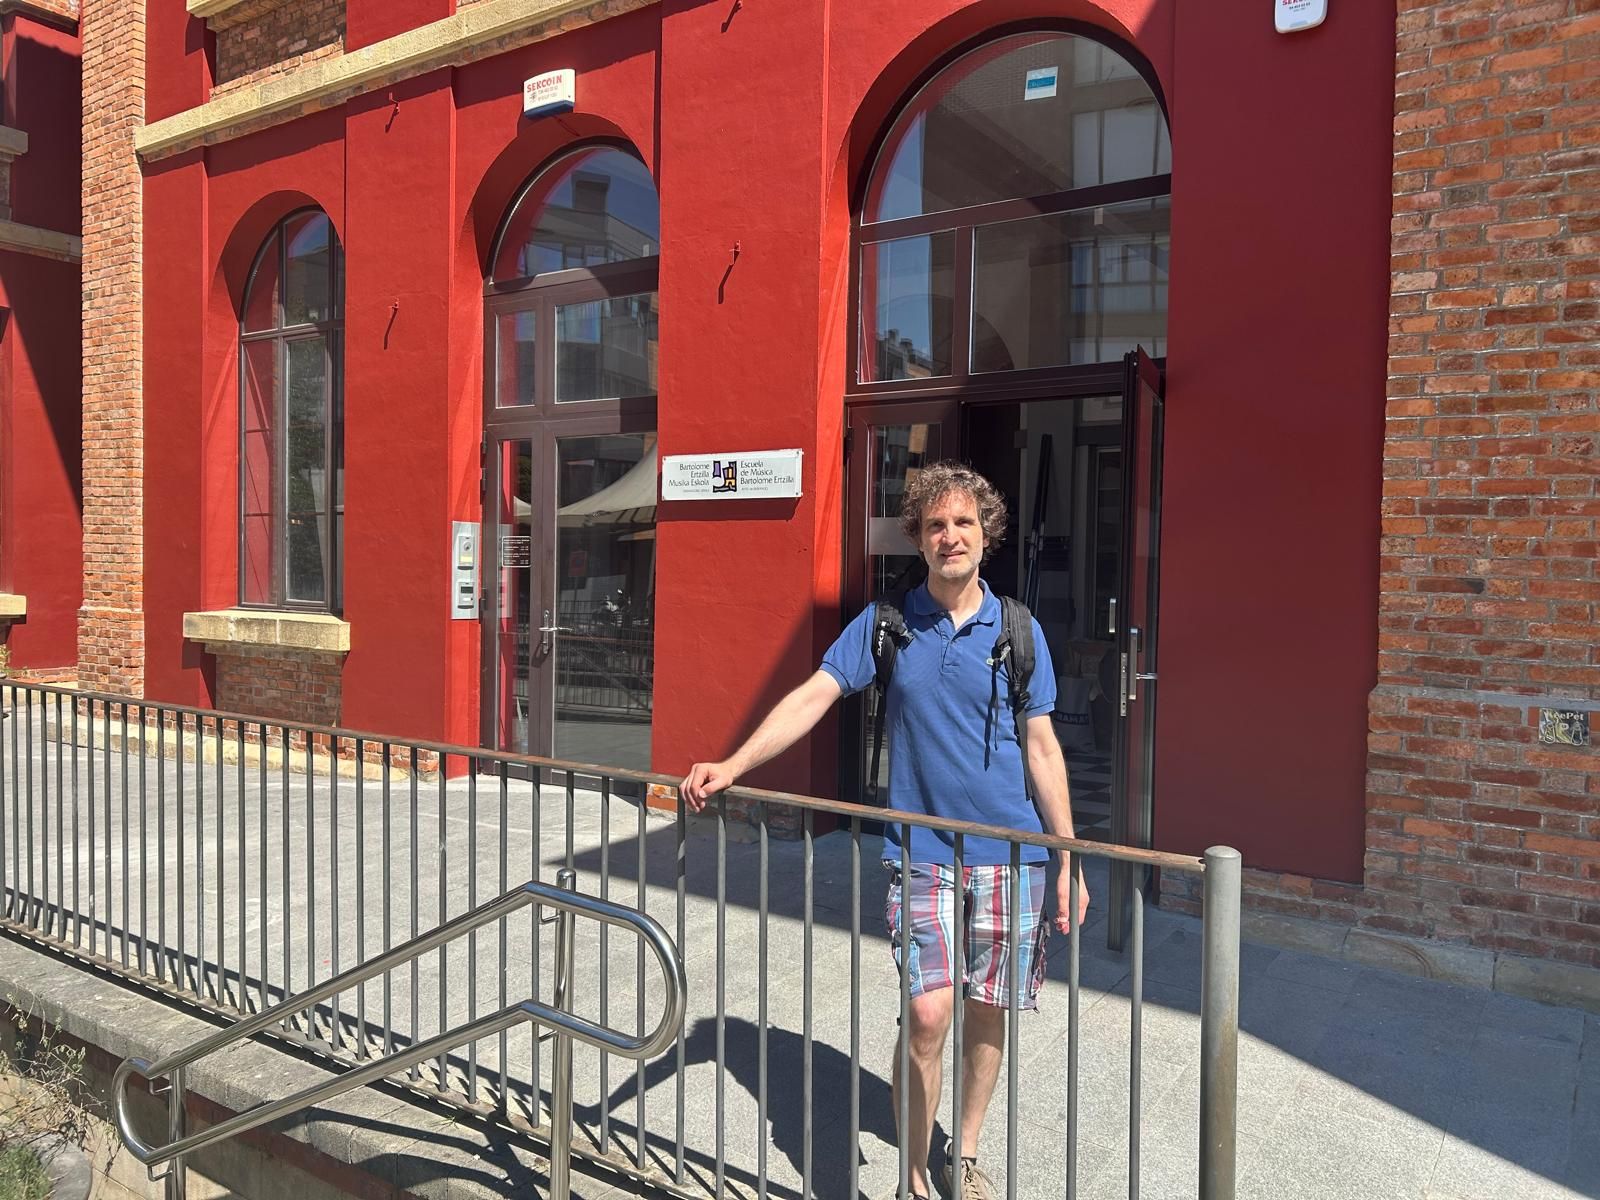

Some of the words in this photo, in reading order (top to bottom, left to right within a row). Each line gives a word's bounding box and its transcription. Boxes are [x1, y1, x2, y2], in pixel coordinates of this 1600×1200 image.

[527, 74, 562, 93] SEKCOIN
[680, 463, 710, 471] Bartolome
[740, 460, 764, 469] Escuela
[669, 479, 690, 487] Musika
[740, 476, 773, 485] Bartolome
[773, 475, 795, 484] Ertzilla
